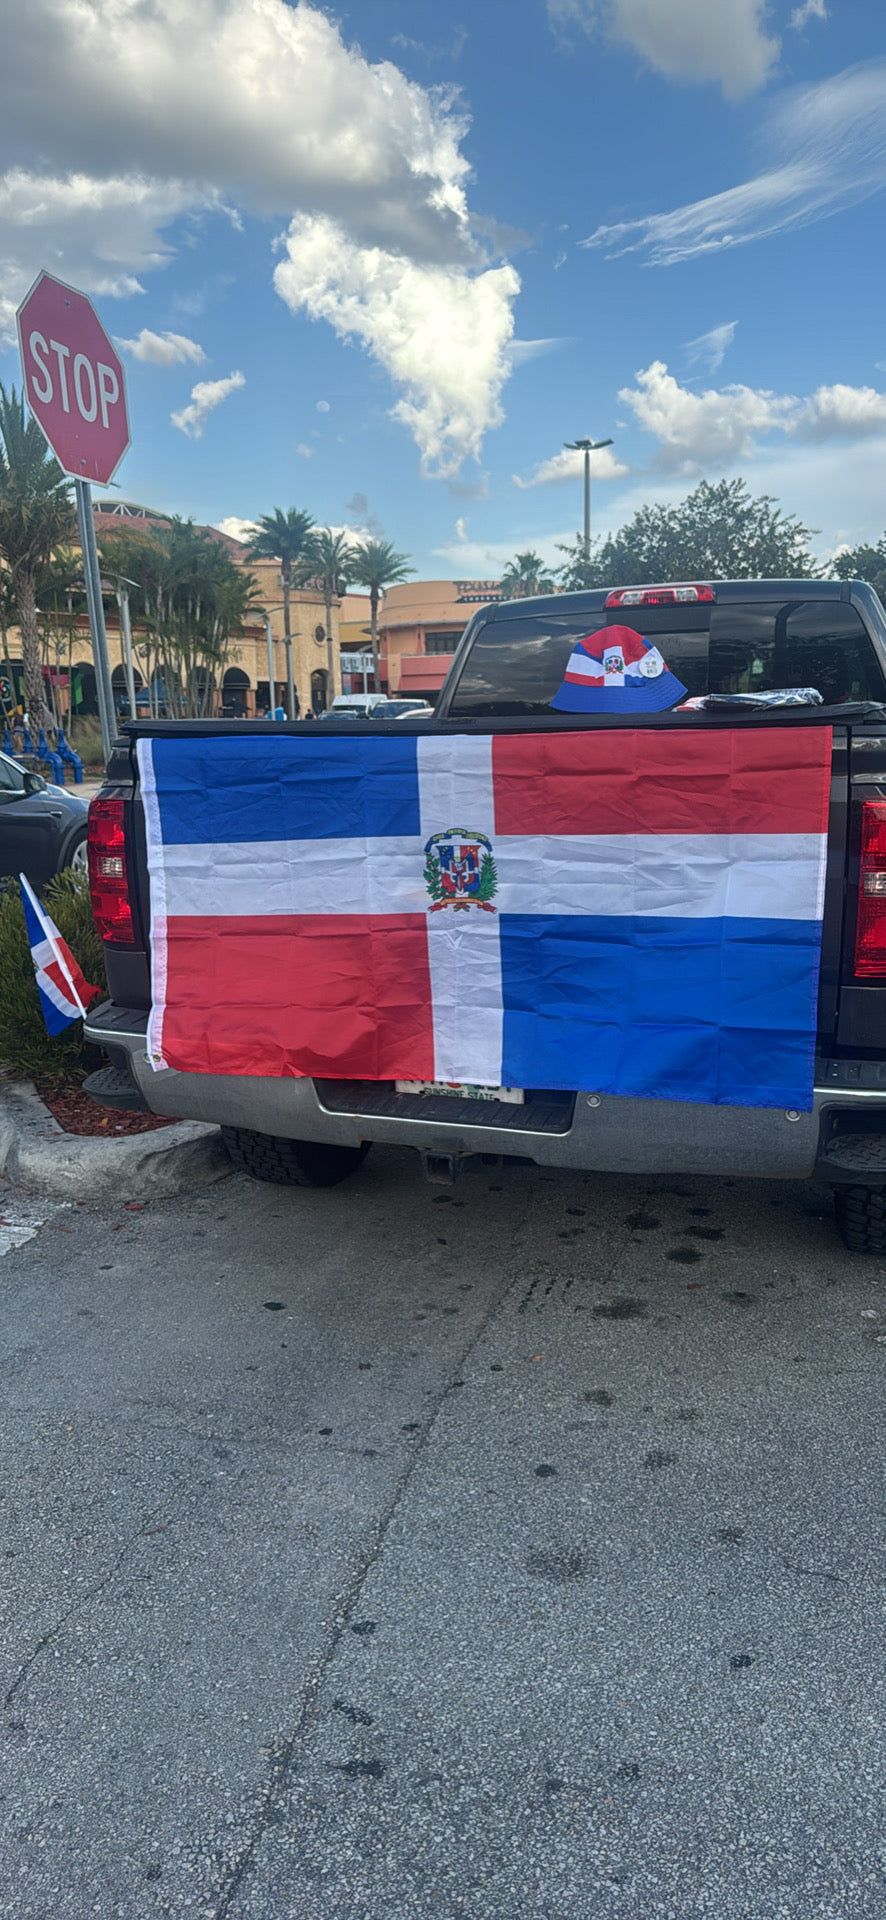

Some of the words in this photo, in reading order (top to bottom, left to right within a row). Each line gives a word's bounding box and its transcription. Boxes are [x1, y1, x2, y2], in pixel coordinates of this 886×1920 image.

[29, 331, 119, 429] STOP
[424, 1087, 464, 1098] SUNSHINE
[468, 1091, 495, 1101] STATE
